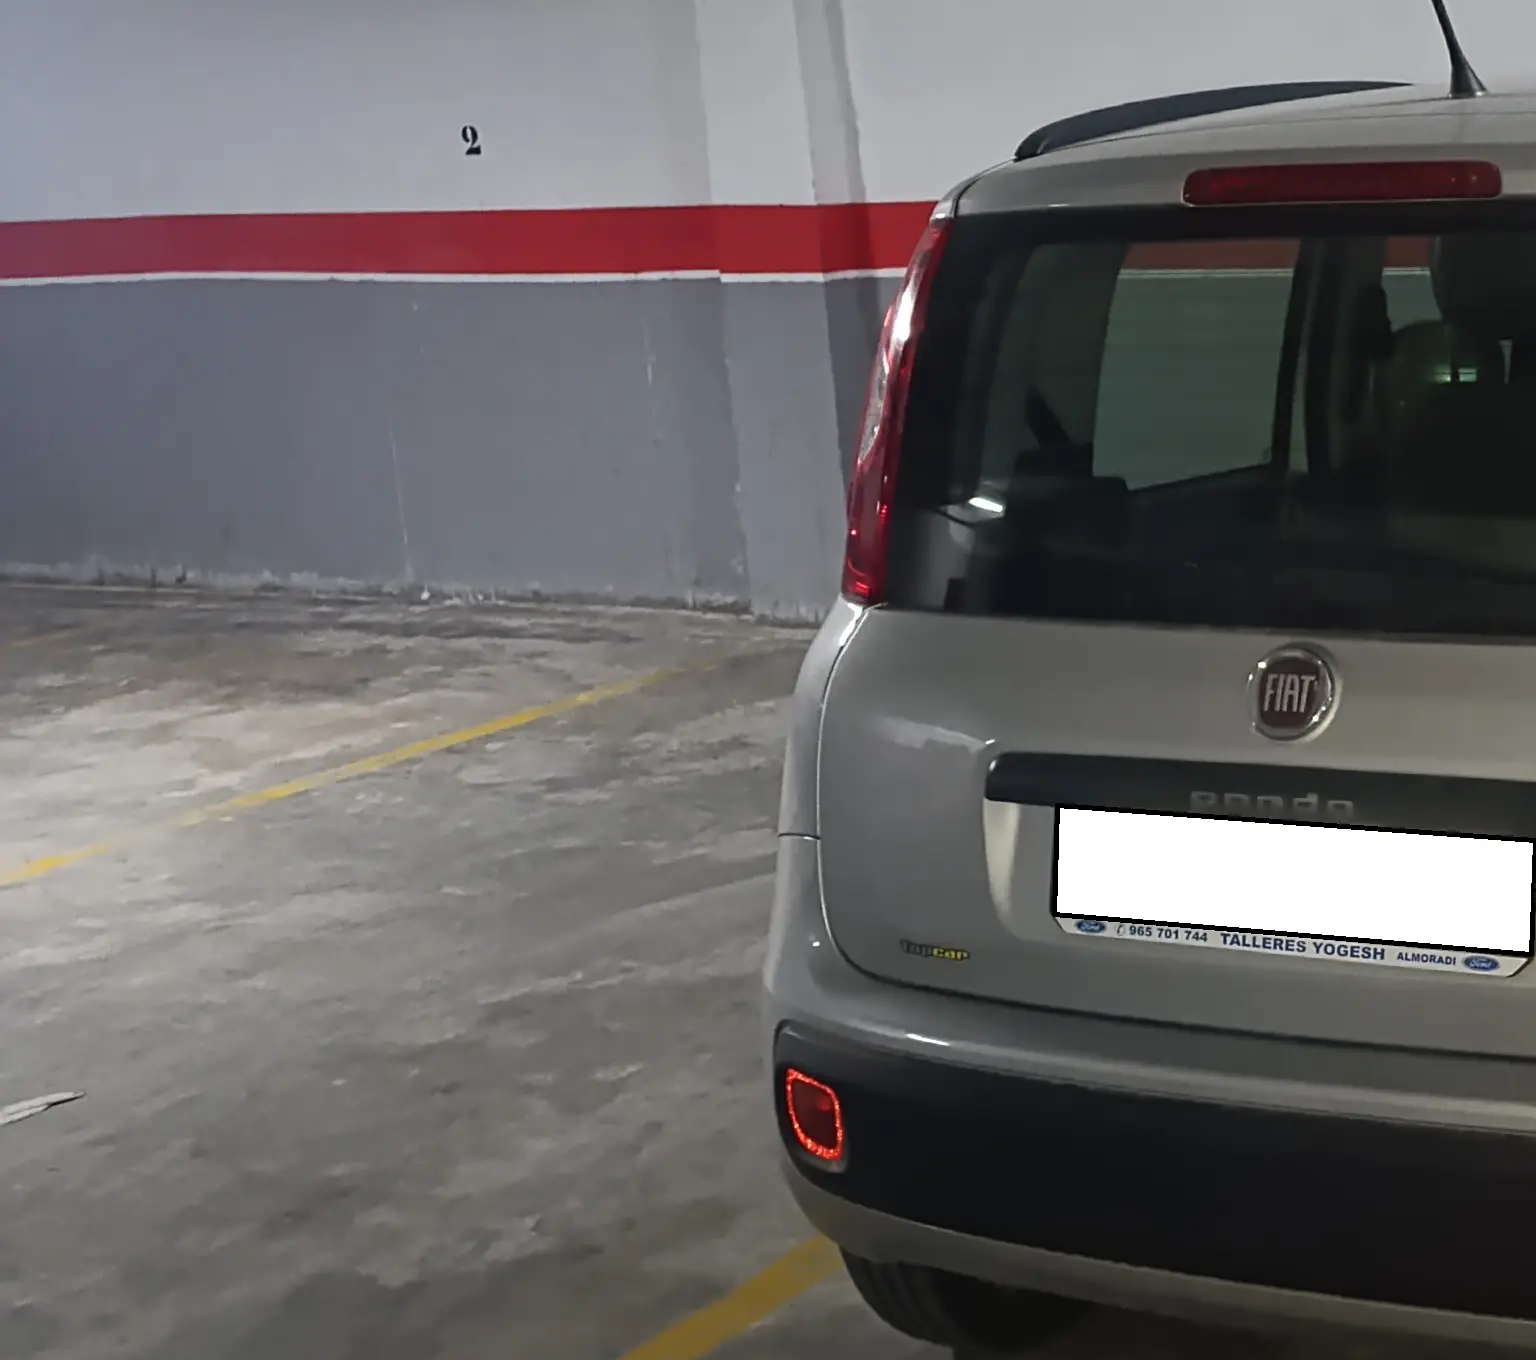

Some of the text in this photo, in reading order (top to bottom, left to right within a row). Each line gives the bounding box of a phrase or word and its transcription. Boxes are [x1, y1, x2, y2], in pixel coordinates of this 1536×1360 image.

[461, 125, 481, 156] 2
[1263, 673, 1316, 712] FIAT
[1129, 925, 1457, 965] 965 701 744 TALLERES YOGESH ALMORADI
